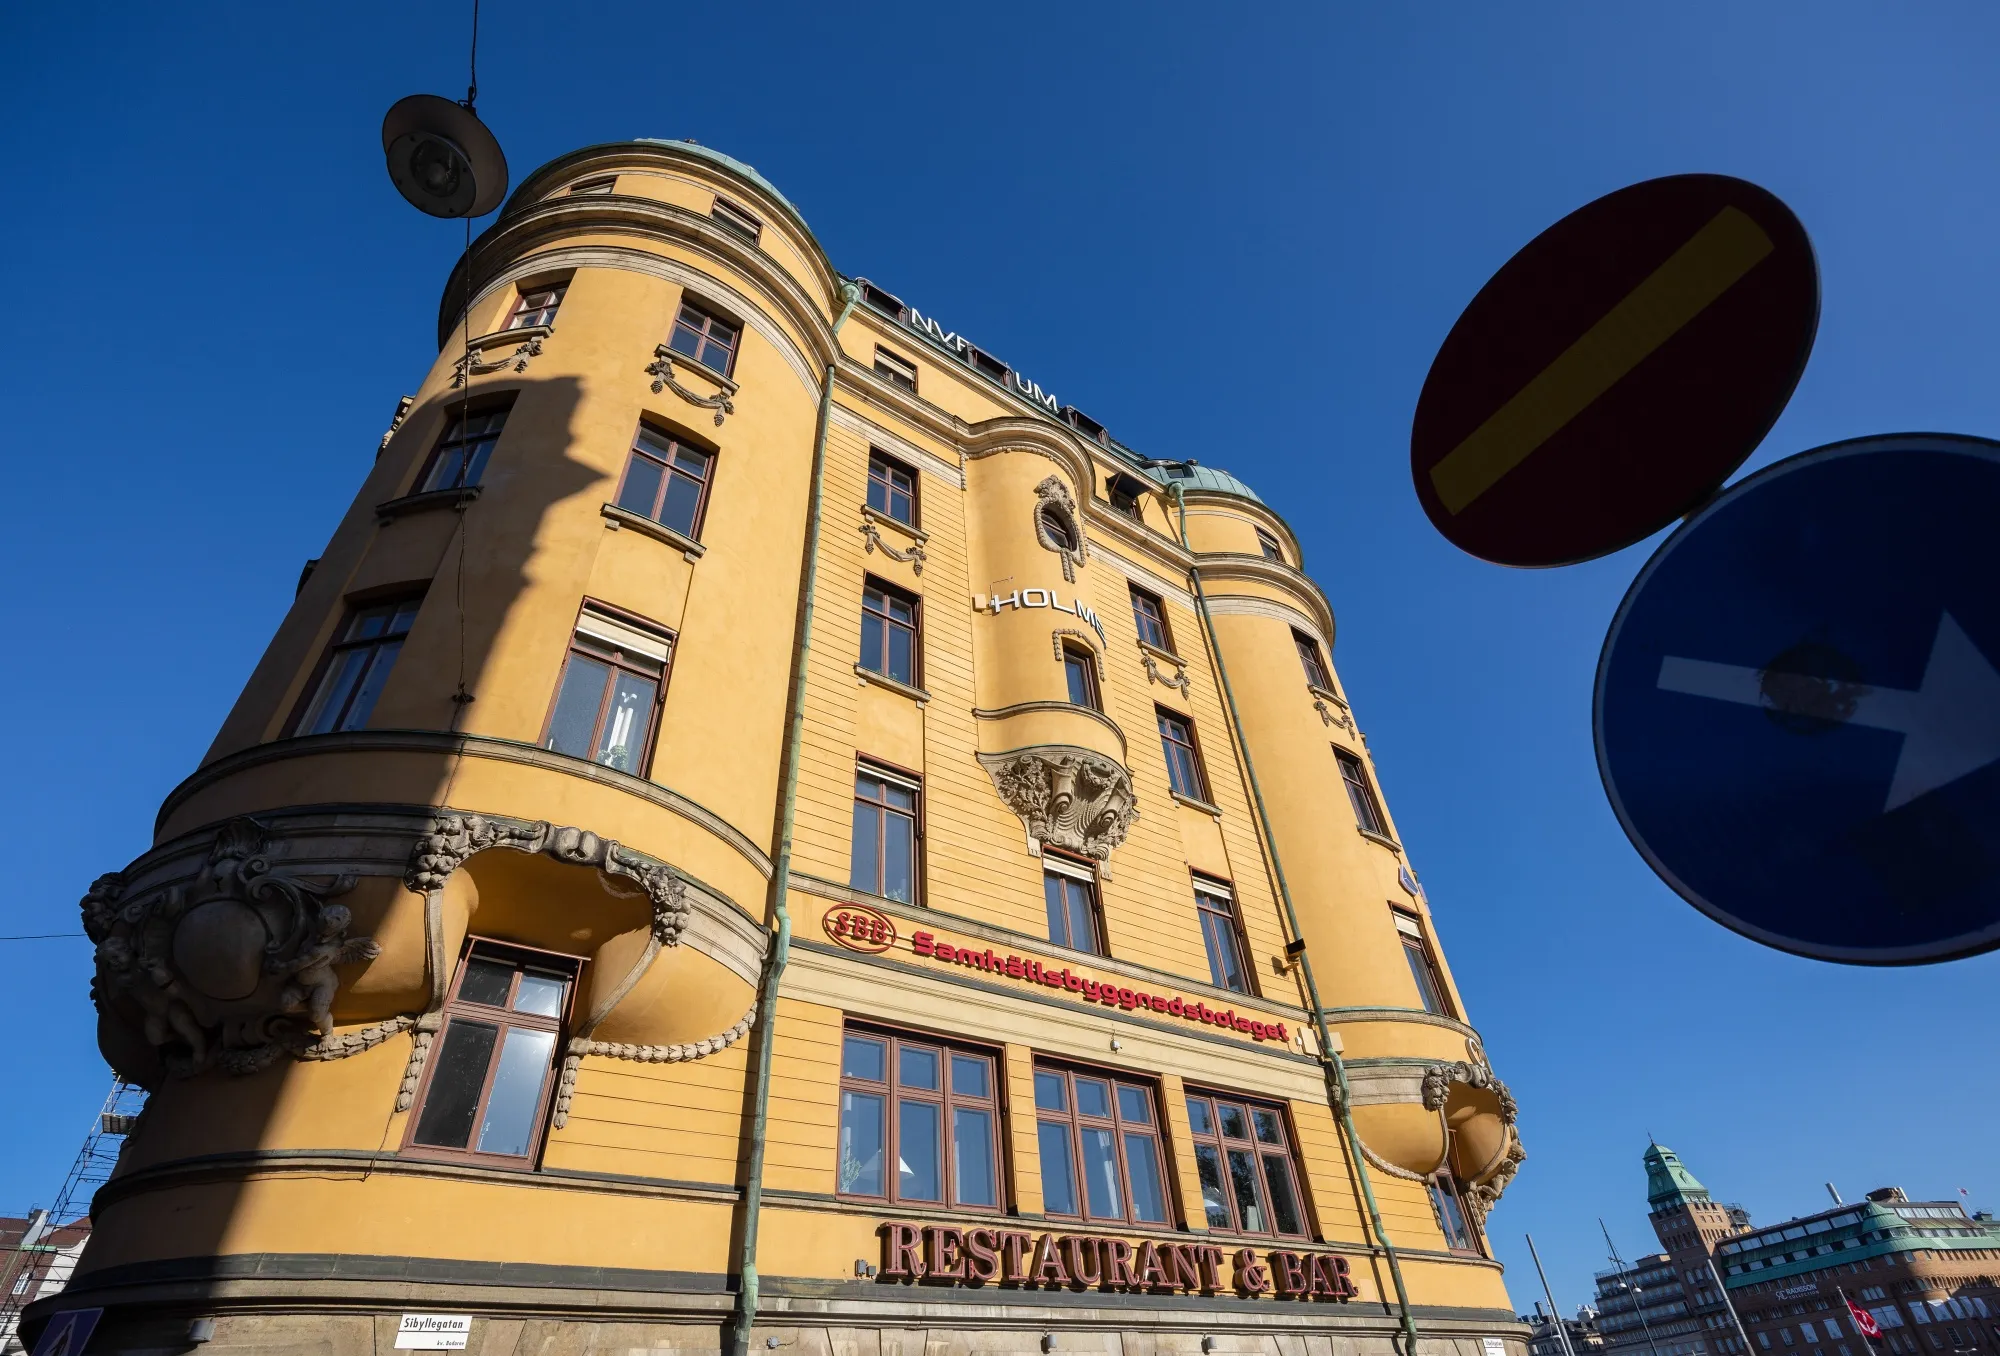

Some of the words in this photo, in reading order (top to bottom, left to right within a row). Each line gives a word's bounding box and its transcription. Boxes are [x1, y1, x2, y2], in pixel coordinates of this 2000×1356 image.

[834, 911, 888, 943] SBB
[914, 930, 1290, 1042] Samhällsbyggnadsbolaget
[882, 1221, 1225, 1291] RESTAURANT
[1234, 1247, 1271, 1293] &
[1273, 1250, 1359, 1297] BAR
[1785, 1283, 1817, 1295] RADISSON
[404, 1317, 463, 1331] Sibyllegatan
